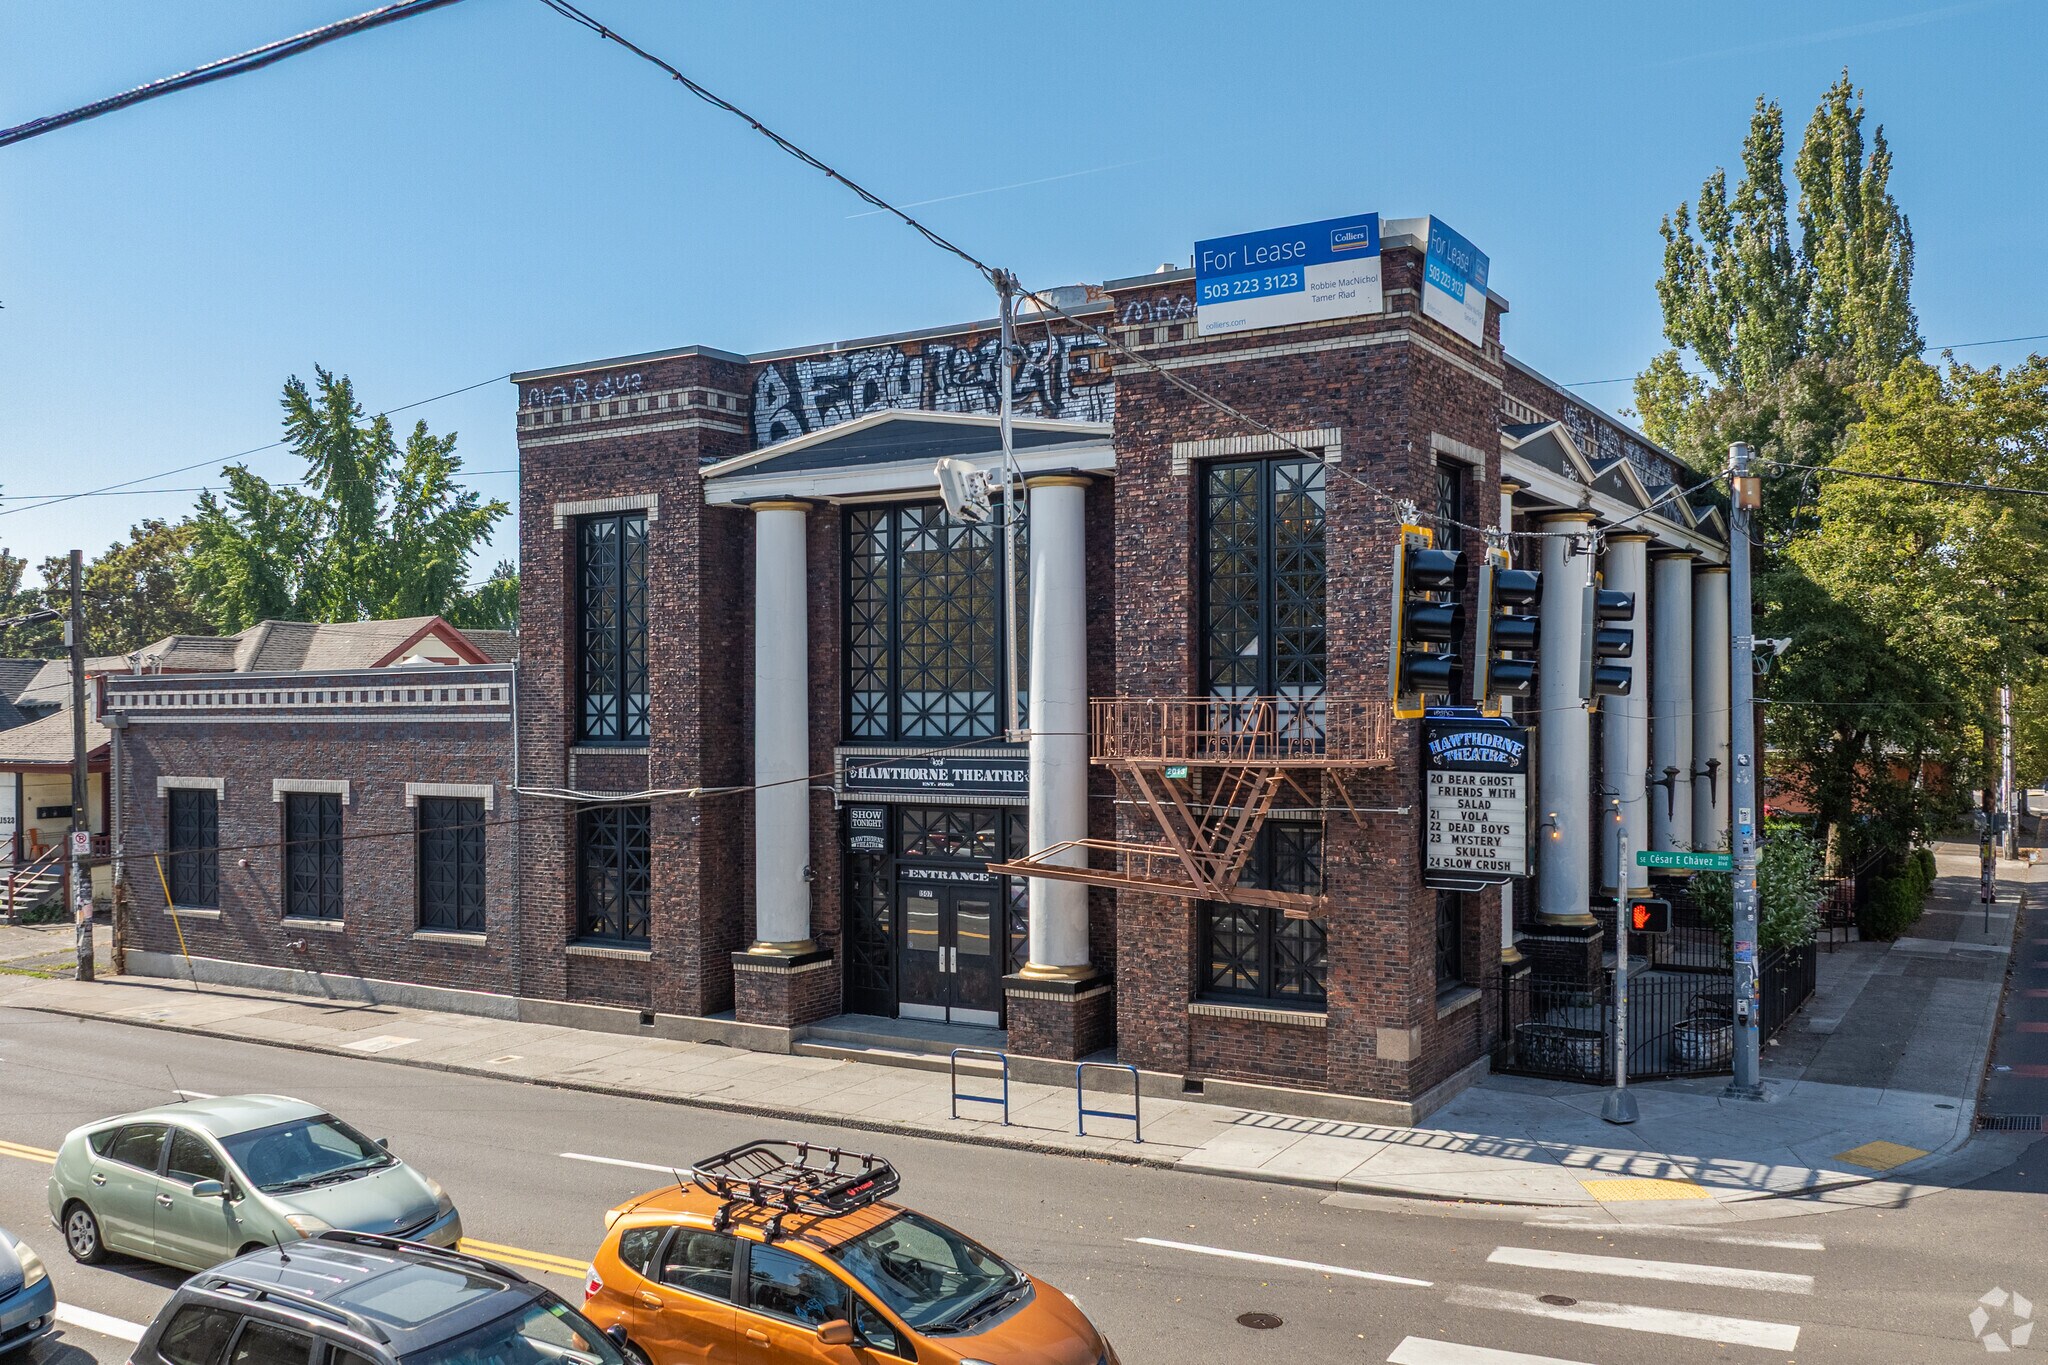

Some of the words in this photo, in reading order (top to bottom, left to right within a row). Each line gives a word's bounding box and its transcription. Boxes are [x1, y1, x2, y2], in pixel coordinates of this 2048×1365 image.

[1335, 231, 1364, 243] Colliers
[1203, 250, 1236, 272] For
[1244, 240, 1306, 266] Lease
[1430, 228, 1446, 254] For
[1447, 240, 1469, 273] Lease
[1204, 283, 1229, 299] 503
[1233, 278, 1259, 295] 223
[1264, 272, 1298, 291] 3123
[1310, 279, 1336, 291] Robbie
[1338, 274, 1378, 288] MacNichol
[1429, 263, 1440, 282] 503
[1440, 270, 1451, 289] 223
[1451, 276, 1464, 297] 3123
[1312, 292, 1336, 303] Tamer
[1338, 289, 1356, 300] Riad
[1205, 318, 1247, 330] colliers.com
[1428, 732, 1525, 758] HAWTHORNE
[1443, 747, 1508, 763] THEATRE
[857, 767, 949, 781] HAWTHORNE
[952, 769, 1024, 783] THEATRE
[1430, 774, 1443, 784] 20
[1448, 775, 1476, 785] BEAR
[1480, 776, 1514, 786] GHOST
[1438, 786, 1483, 797] FRIENDS
[1489, 788, 1516, 798] WITH
[1458, 799, 1491, 810] SALAD
[852, 810, 882, 819] SHOW
[1430, 810, 1440, 819] 21
[1461, 811, 1488, 822] VOLA
[852, 818, 882, 828] TONIGHT
[1430, 821, 1441, 831] 22
[1448, 823, 1475, 833] DEAD
[1481, 824, 1510, 835] BOYS
[1430, 833, 1441, 843] 23
[1451, 834, 1502, 847] MYSTERY
[1455, 846, 1496, 858] SKULLS
[1429, 857, 1440, 867] 24
[1443, 858, 1472, 869] SLOW
[1476, 860, 1511, 871] CRUSH
[1650, 854, 1673, 864] César
[1676, 856, 1681, 865] E
[1683, 854, 1713, 866] Chávez
[907, 869, 990, 882] ENTRANCE
